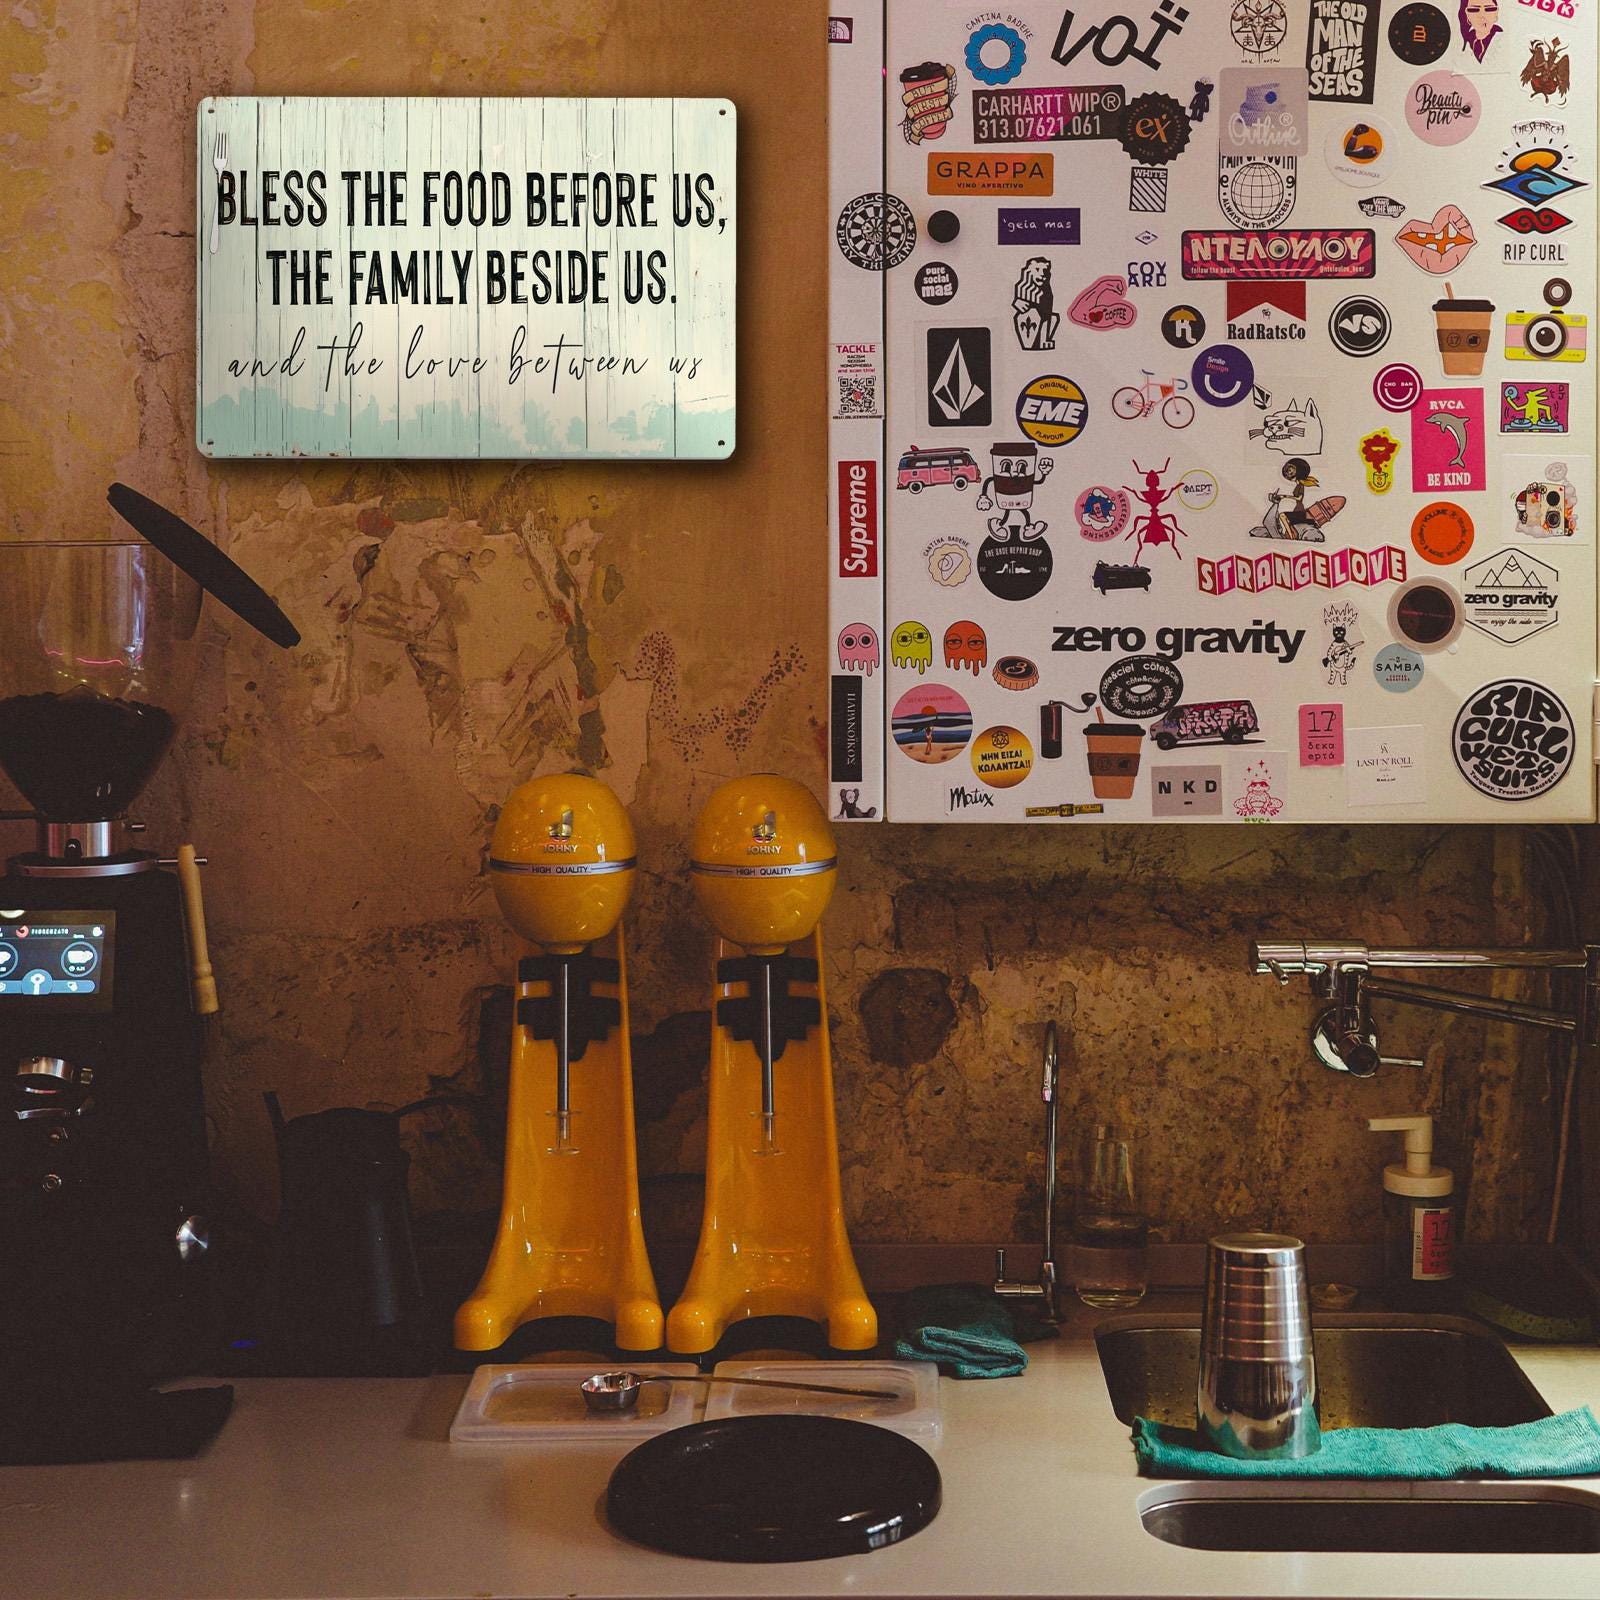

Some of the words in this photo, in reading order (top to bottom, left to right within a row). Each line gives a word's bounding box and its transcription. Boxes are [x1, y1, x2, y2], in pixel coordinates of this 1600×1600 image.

[1313, 1, 1340, 17] THE
[1341, 2, 1367, 23] OLD
[966, 12, 1002, 30] CANTINA
[1006, 14, 1034, 40] BADEHE
[1312, 18, 1363, 54] MAN
[1311, 51, 1332, 73] OF
[1332, 48, 1364, 73] THE
[912, 84, 935, 99] BUT
[1308, 68, 1364, 97] SEAS
[978, 94, 1063, 117] CARHARTT
[1415, 83, 1463, 115] Beauty
[978, 115, 1101, 139] 313.07621.061
[1426, 110, 1453, 130] pin
[936, 161, 1044, 179] GRAPPA
[1133, 168, 1167, 178] WHITE
[218, 170, 327, 227] BLESS
[341, 171, 407, 226] THE
[423, 171, 511, 227] FOOD
[527, 172, 658, 227] BEFORE
[672, 172, 728, 234] US,
[1222, 198, 1242, 224] ALWAYS
[1267, 198, 1293, 226] PROCESS
[1044, 221, 1072, 229] mas
[837, 230, 858, 259] PLAY
[889, 232, 916, 265] GAME
[1504, 244, 1526, 260] RIP
[1530, 244, 1565, 260] CURL
[266, 250, 333, 305] THE
[350, 250, 473, 305] FAMILY
[487, 250, 609, 305] BESIDE
[624, 250, 677, 305] US.
[925, 267, 946, 275] pure
[1127, 261, 1167, 275] COY
[923, 273, 950, 284] social
[1128, 274, 1167, 287] ARD
[921, 282, 953, 298] mag
[1104, 307, 1127, 321] COFFEE
[1227, 323, 1306, 340] RadRatsCo
[1338, 314, 1382, 335] VS
[227, 326, 305, 379] and
[317, 322, 384, 393] the
[405, 324, 488, 381] love
[508, 326, 649, 394] between
[668, 353, 704, 381] us
[836, 344, 876, 353] TACKLE
[1206, 362, 1229, 373] Design
[1208, 356, 1226, 365] Smile
[1040, 382, 1069, 392] ORIGINAL
[1020, 398, 1085, 425] EME
[1429, 400, 1465, 410] RVCA
[1035, 430, 1064, 440] FLAVOUR
[1427, 473, 1441, 487] BE
[1443, 472, 1471, 486] KIND
[843, 464, 874, 574] Supreme
[1201, 550, 1406, 592] STRANGELOVE
[1464, 593, 1499, 604] zero
[1502, 591, 1558, 608] gravity
[1324, 616, 1340, 627] FUCK
[1507, 617, 1517, 625] the
[1051, 626, 1147, 652] zero
[1156, 620, 1306, 663] gravity
[1376, 663, 1421, 672] SAMBA
[1471, 685, 1561, 722] RIP
[1307, 711, 1336, 732] 17
[1460, 717, 1568, 764] CURL
[981, 752, 999, 761] ΜΗΝ
[1356, 758, 1378, 767] LASH
[1391, 757, 1413, 765] ROLL
[1461, 743, 1540, 769] WET
[1473, 759, 1555, 788] SUITS
[950, 786, 994, 811] Matix
